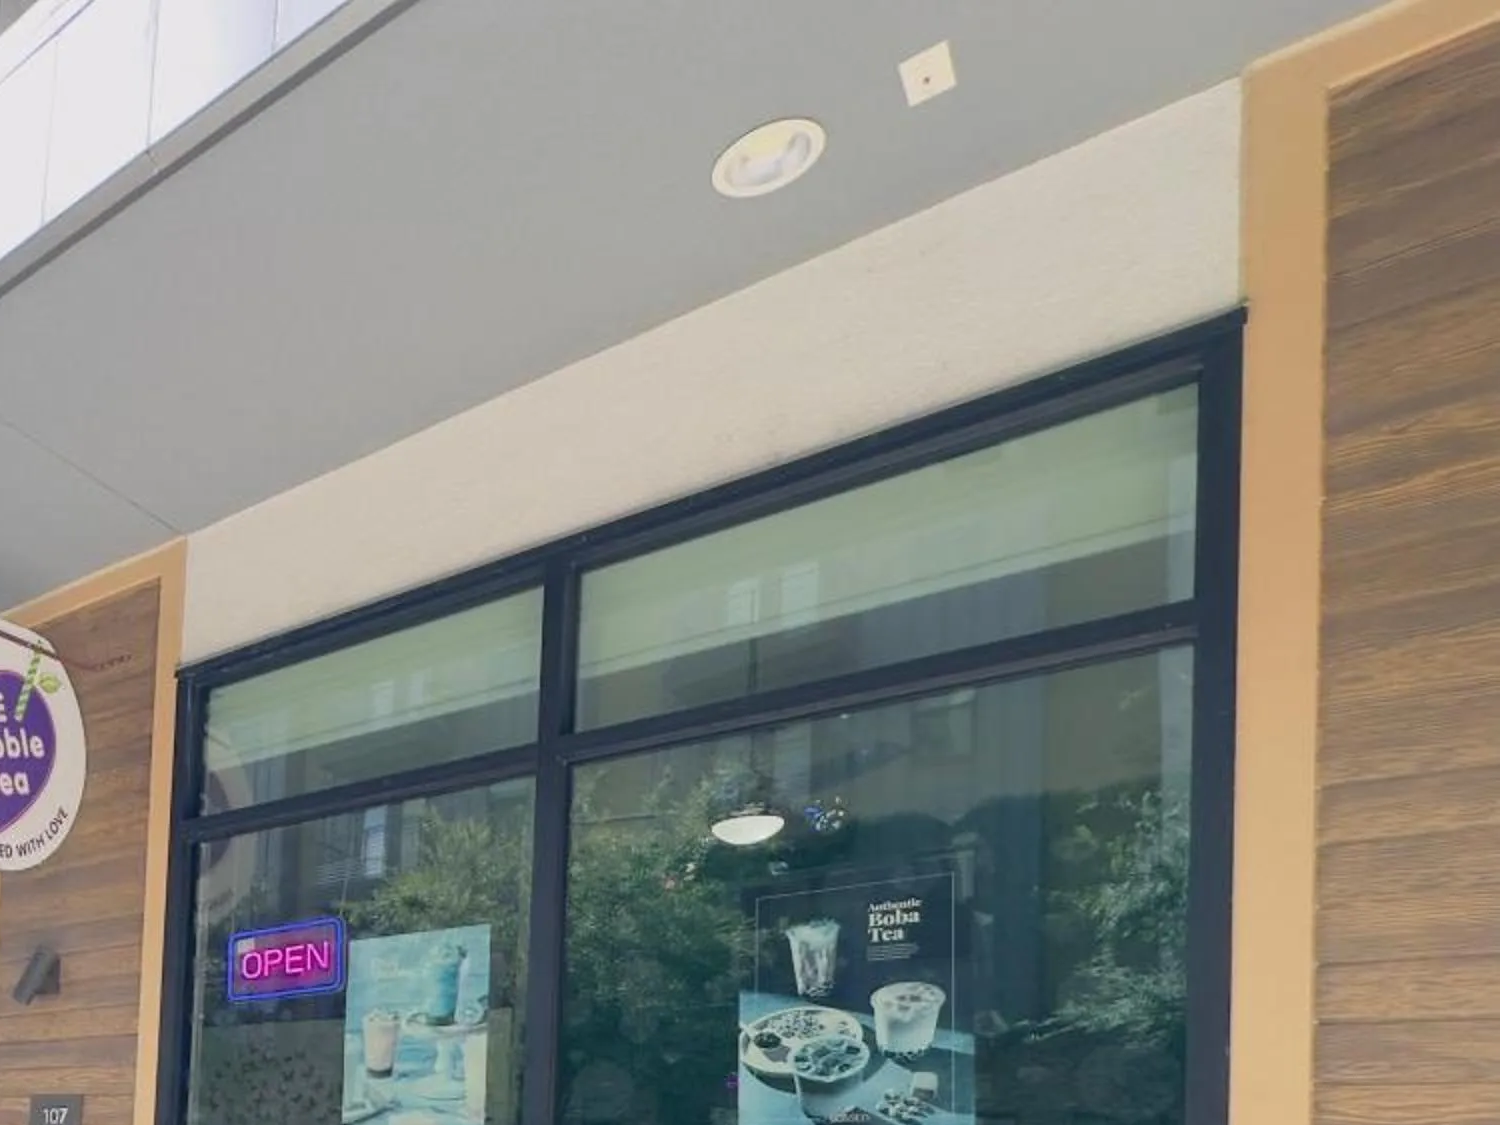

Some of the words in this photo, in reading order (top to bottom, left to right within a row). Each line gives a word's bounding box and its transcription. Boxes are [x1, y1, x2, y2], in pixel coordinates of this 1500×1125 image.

[16, 836, 45, 857] WITH
[47, 807, 69, 840] LOVE
[868, 897, 923, 912] Authentic
[868, 909, 920, 927] Boba
[868, 927, 903, 942] Tea
[241, 941, 330, 980] OPEN
[42, 1108, 68, 1125] 107
